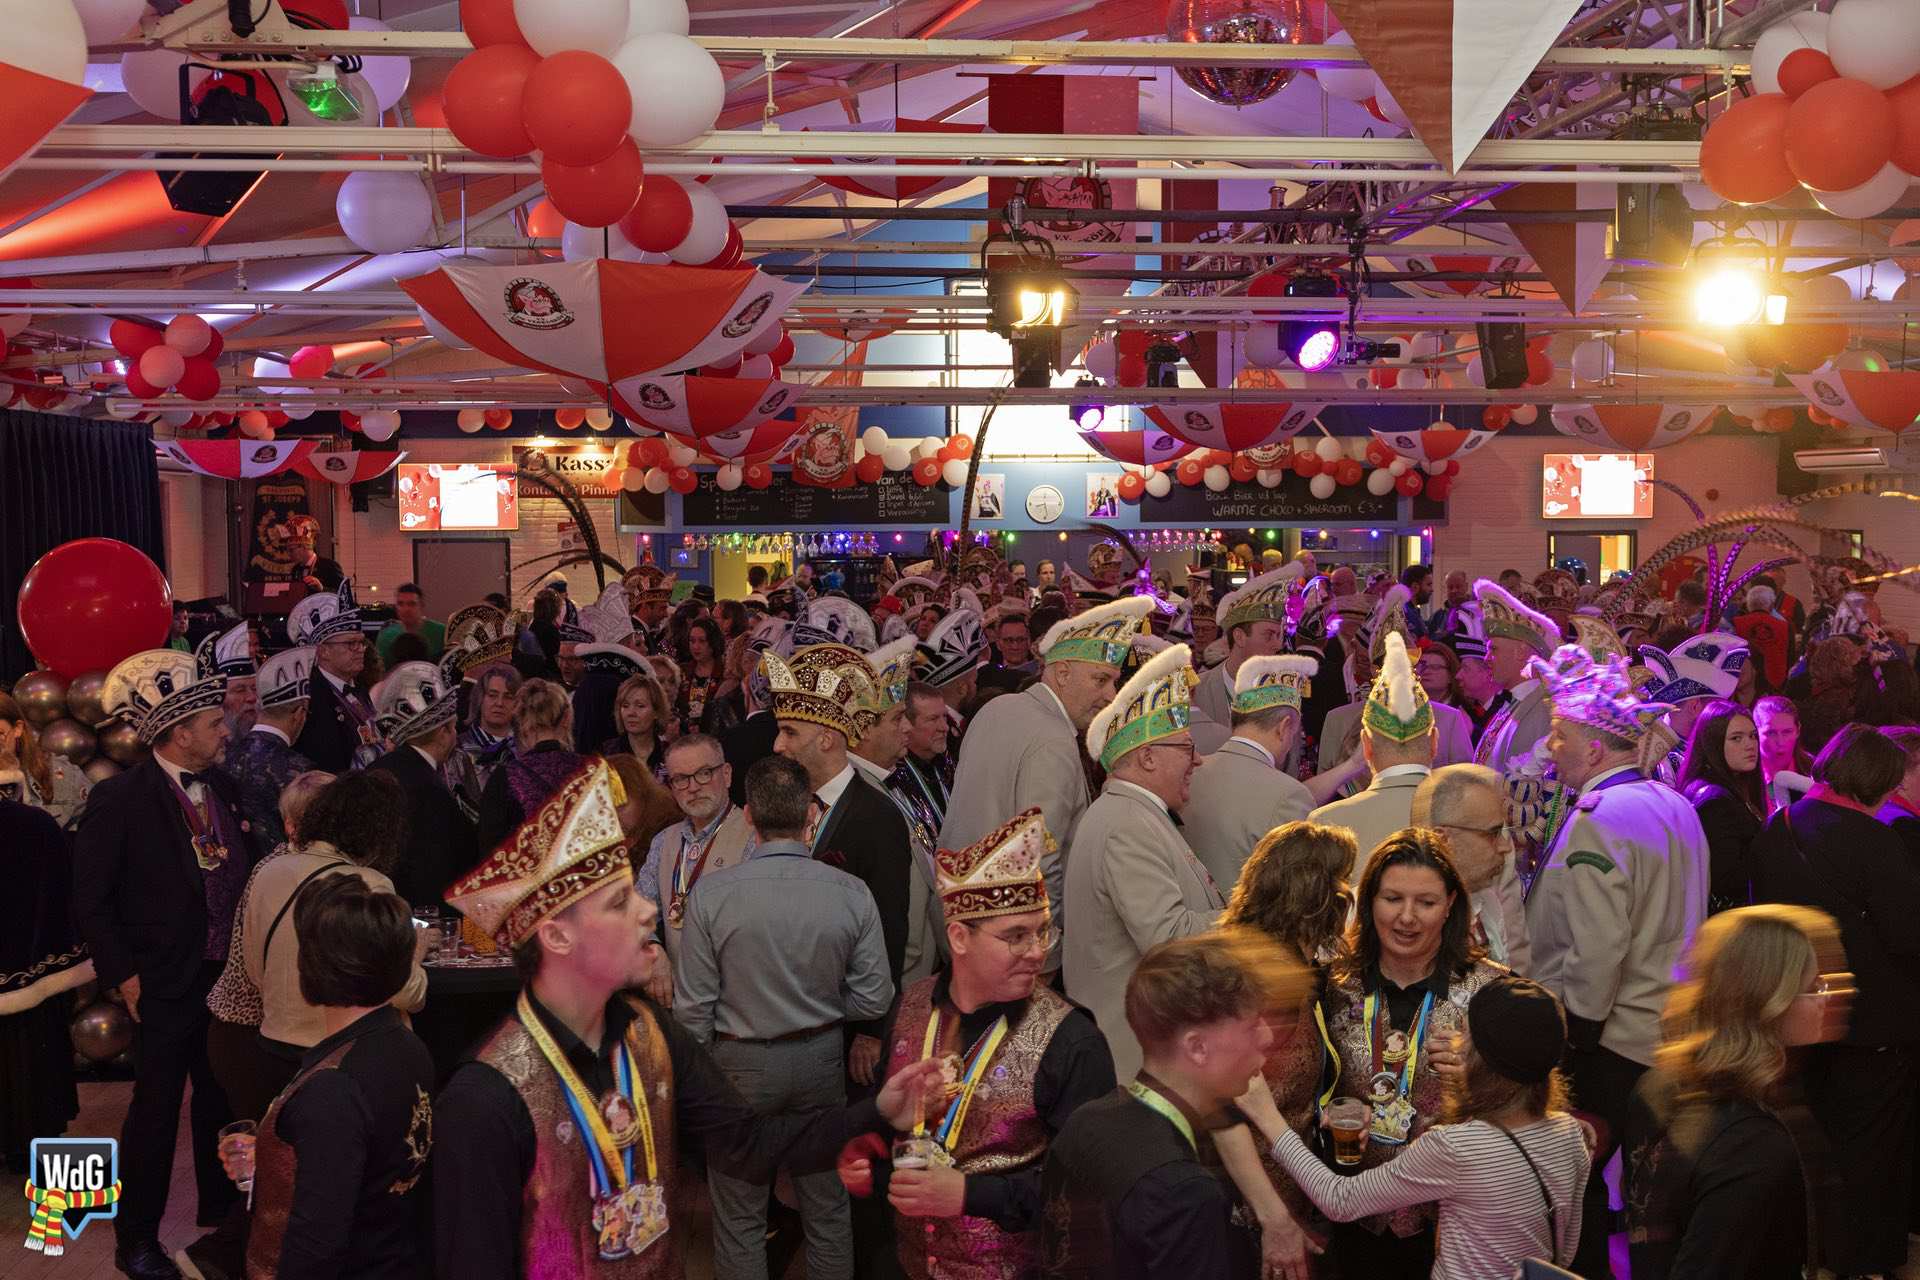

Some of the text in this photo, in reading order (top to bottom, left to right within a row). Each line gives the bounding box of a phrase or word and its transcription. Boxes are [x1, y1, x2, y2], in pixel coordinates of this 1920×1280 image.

[555, 455, 612, 472] Kass
[581, 483, 618, 496] Pinne
[1212, 503, 1256, 517] WARME
